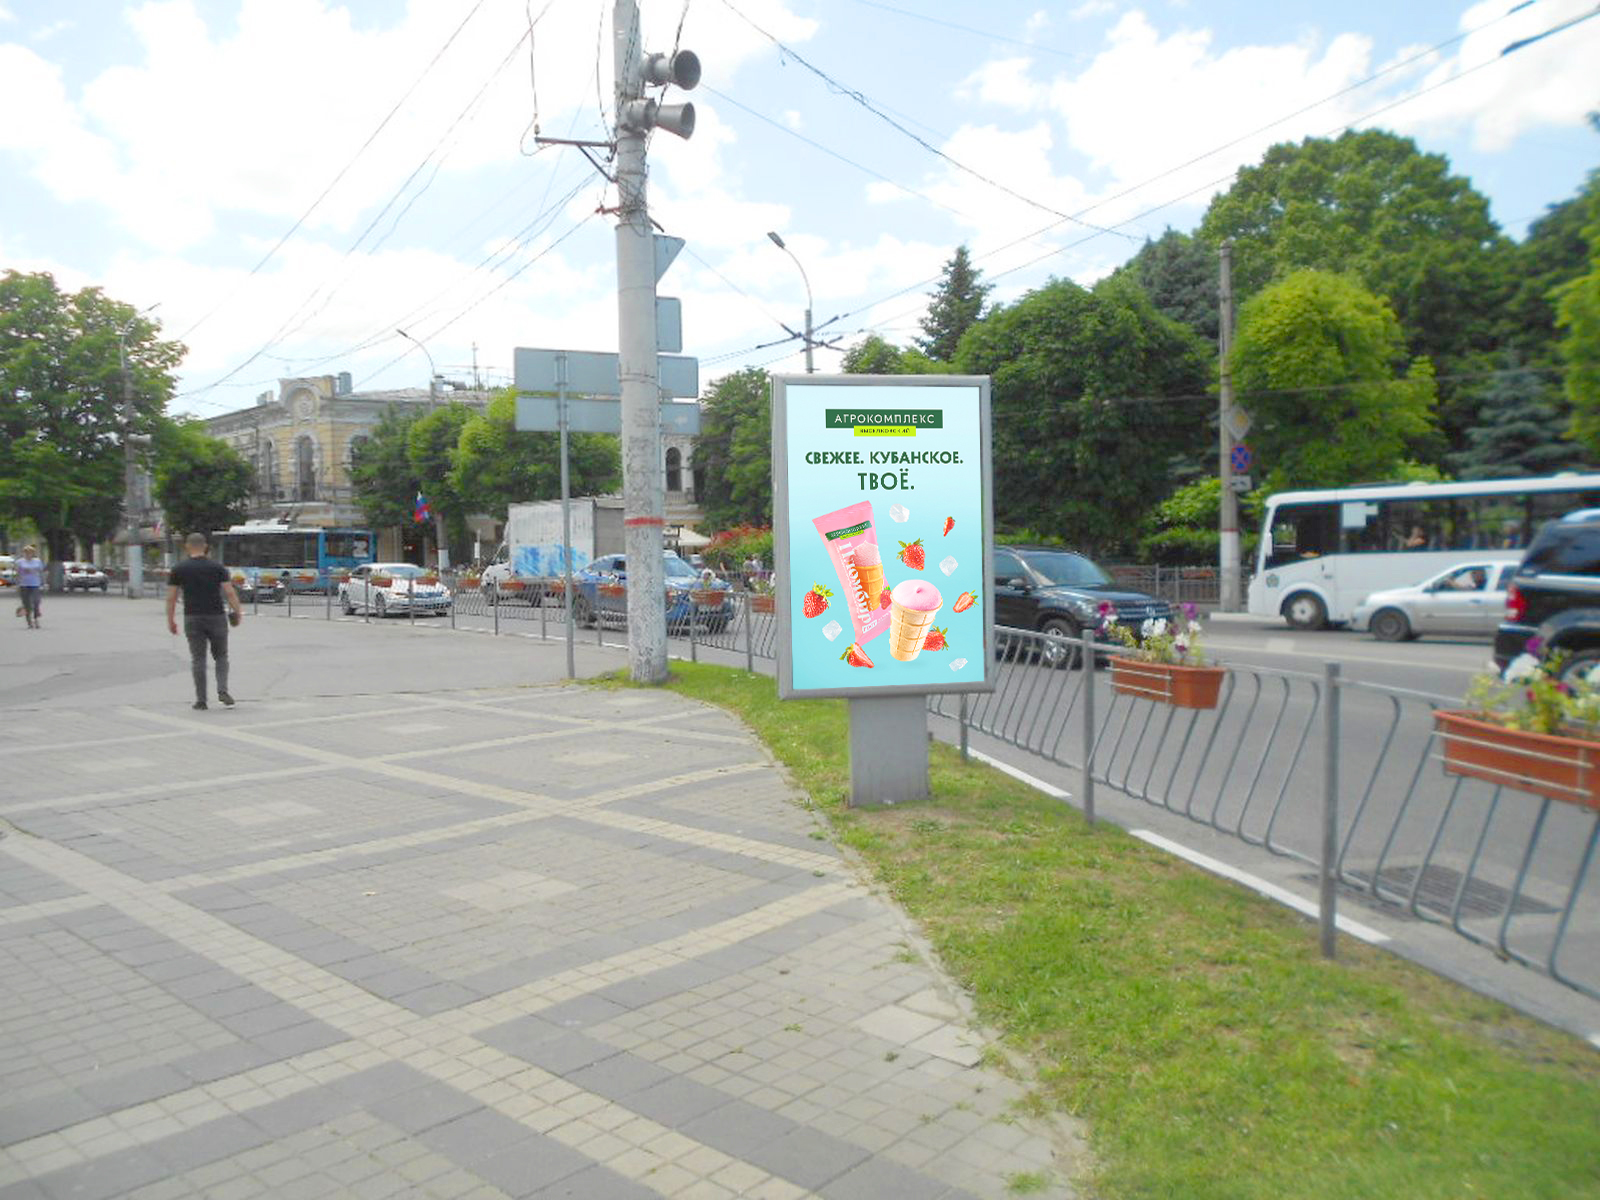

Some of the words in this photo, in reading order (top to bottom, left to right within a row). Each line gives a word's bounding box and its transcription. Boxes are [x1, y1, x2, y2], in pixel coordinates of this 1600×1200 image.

[834, 413, 935, 424] АГРОКОМПЛЕКС
[805, 451, 864, 465] СВЕЖЕЕ.
[870, 451, 964, 465] КУБАНСКОЕ.
[857, 468, 915, 490] ТВОЁ.
